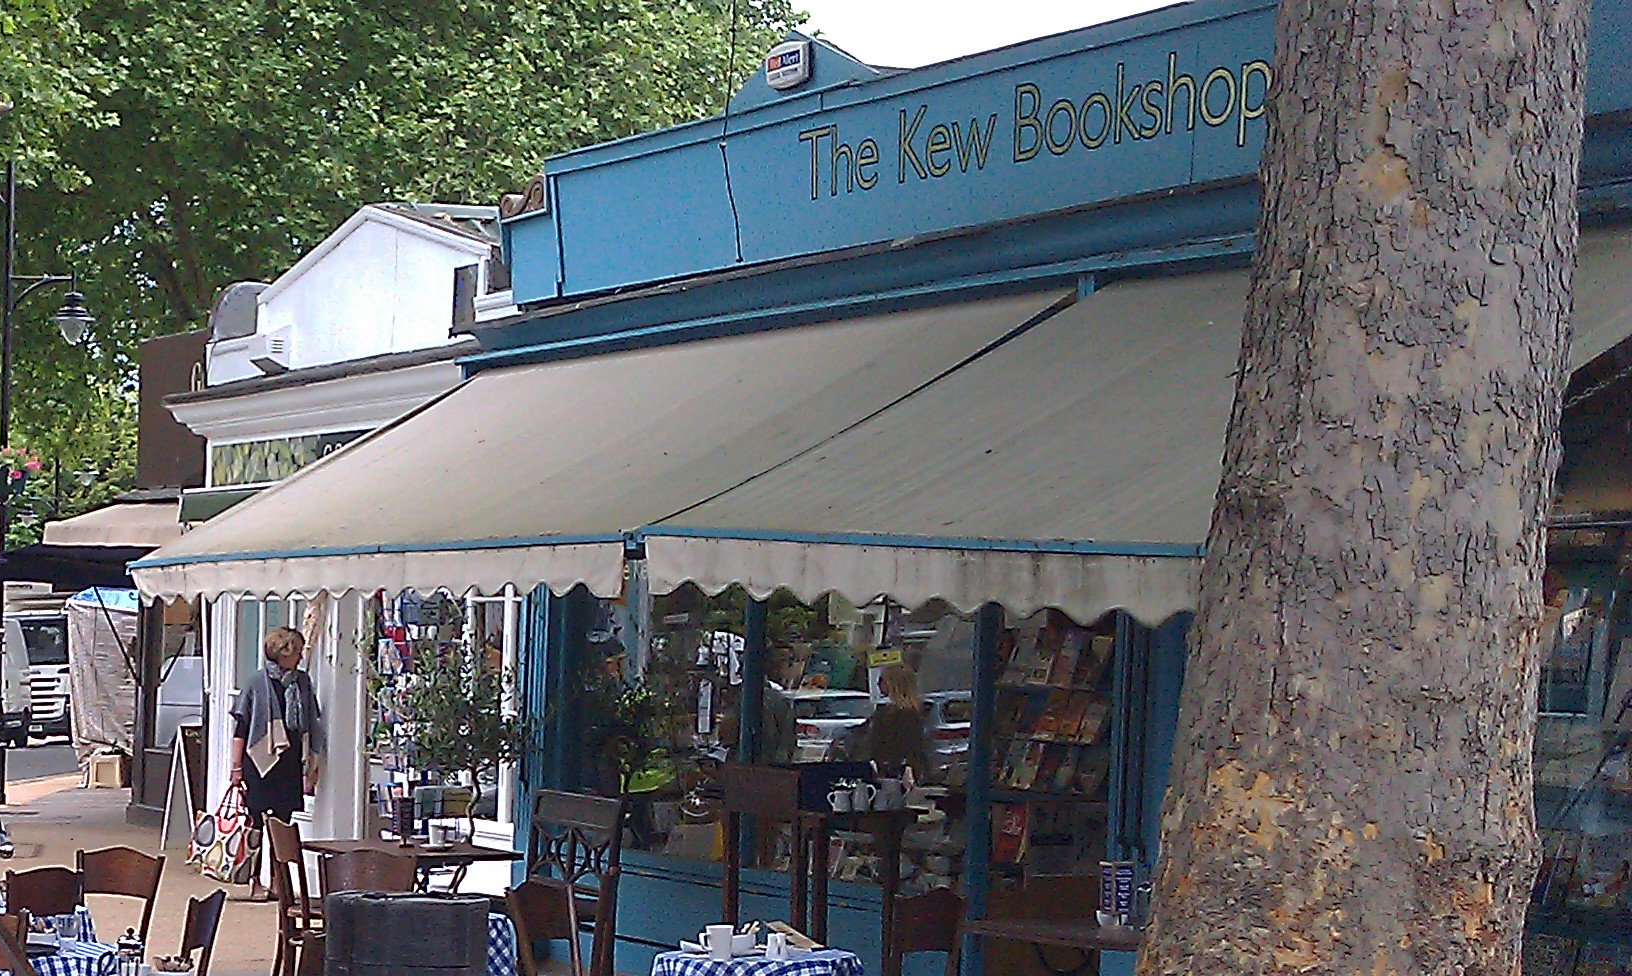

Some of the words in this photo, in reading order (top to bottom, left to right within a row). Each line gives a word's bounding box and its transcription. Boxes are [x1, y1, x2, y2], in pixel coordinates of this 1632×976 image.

[799, 124, 879, 200] The
[897, 104, 998, 184] Kew
[1013, 51, 1273, 163] Bookshop
